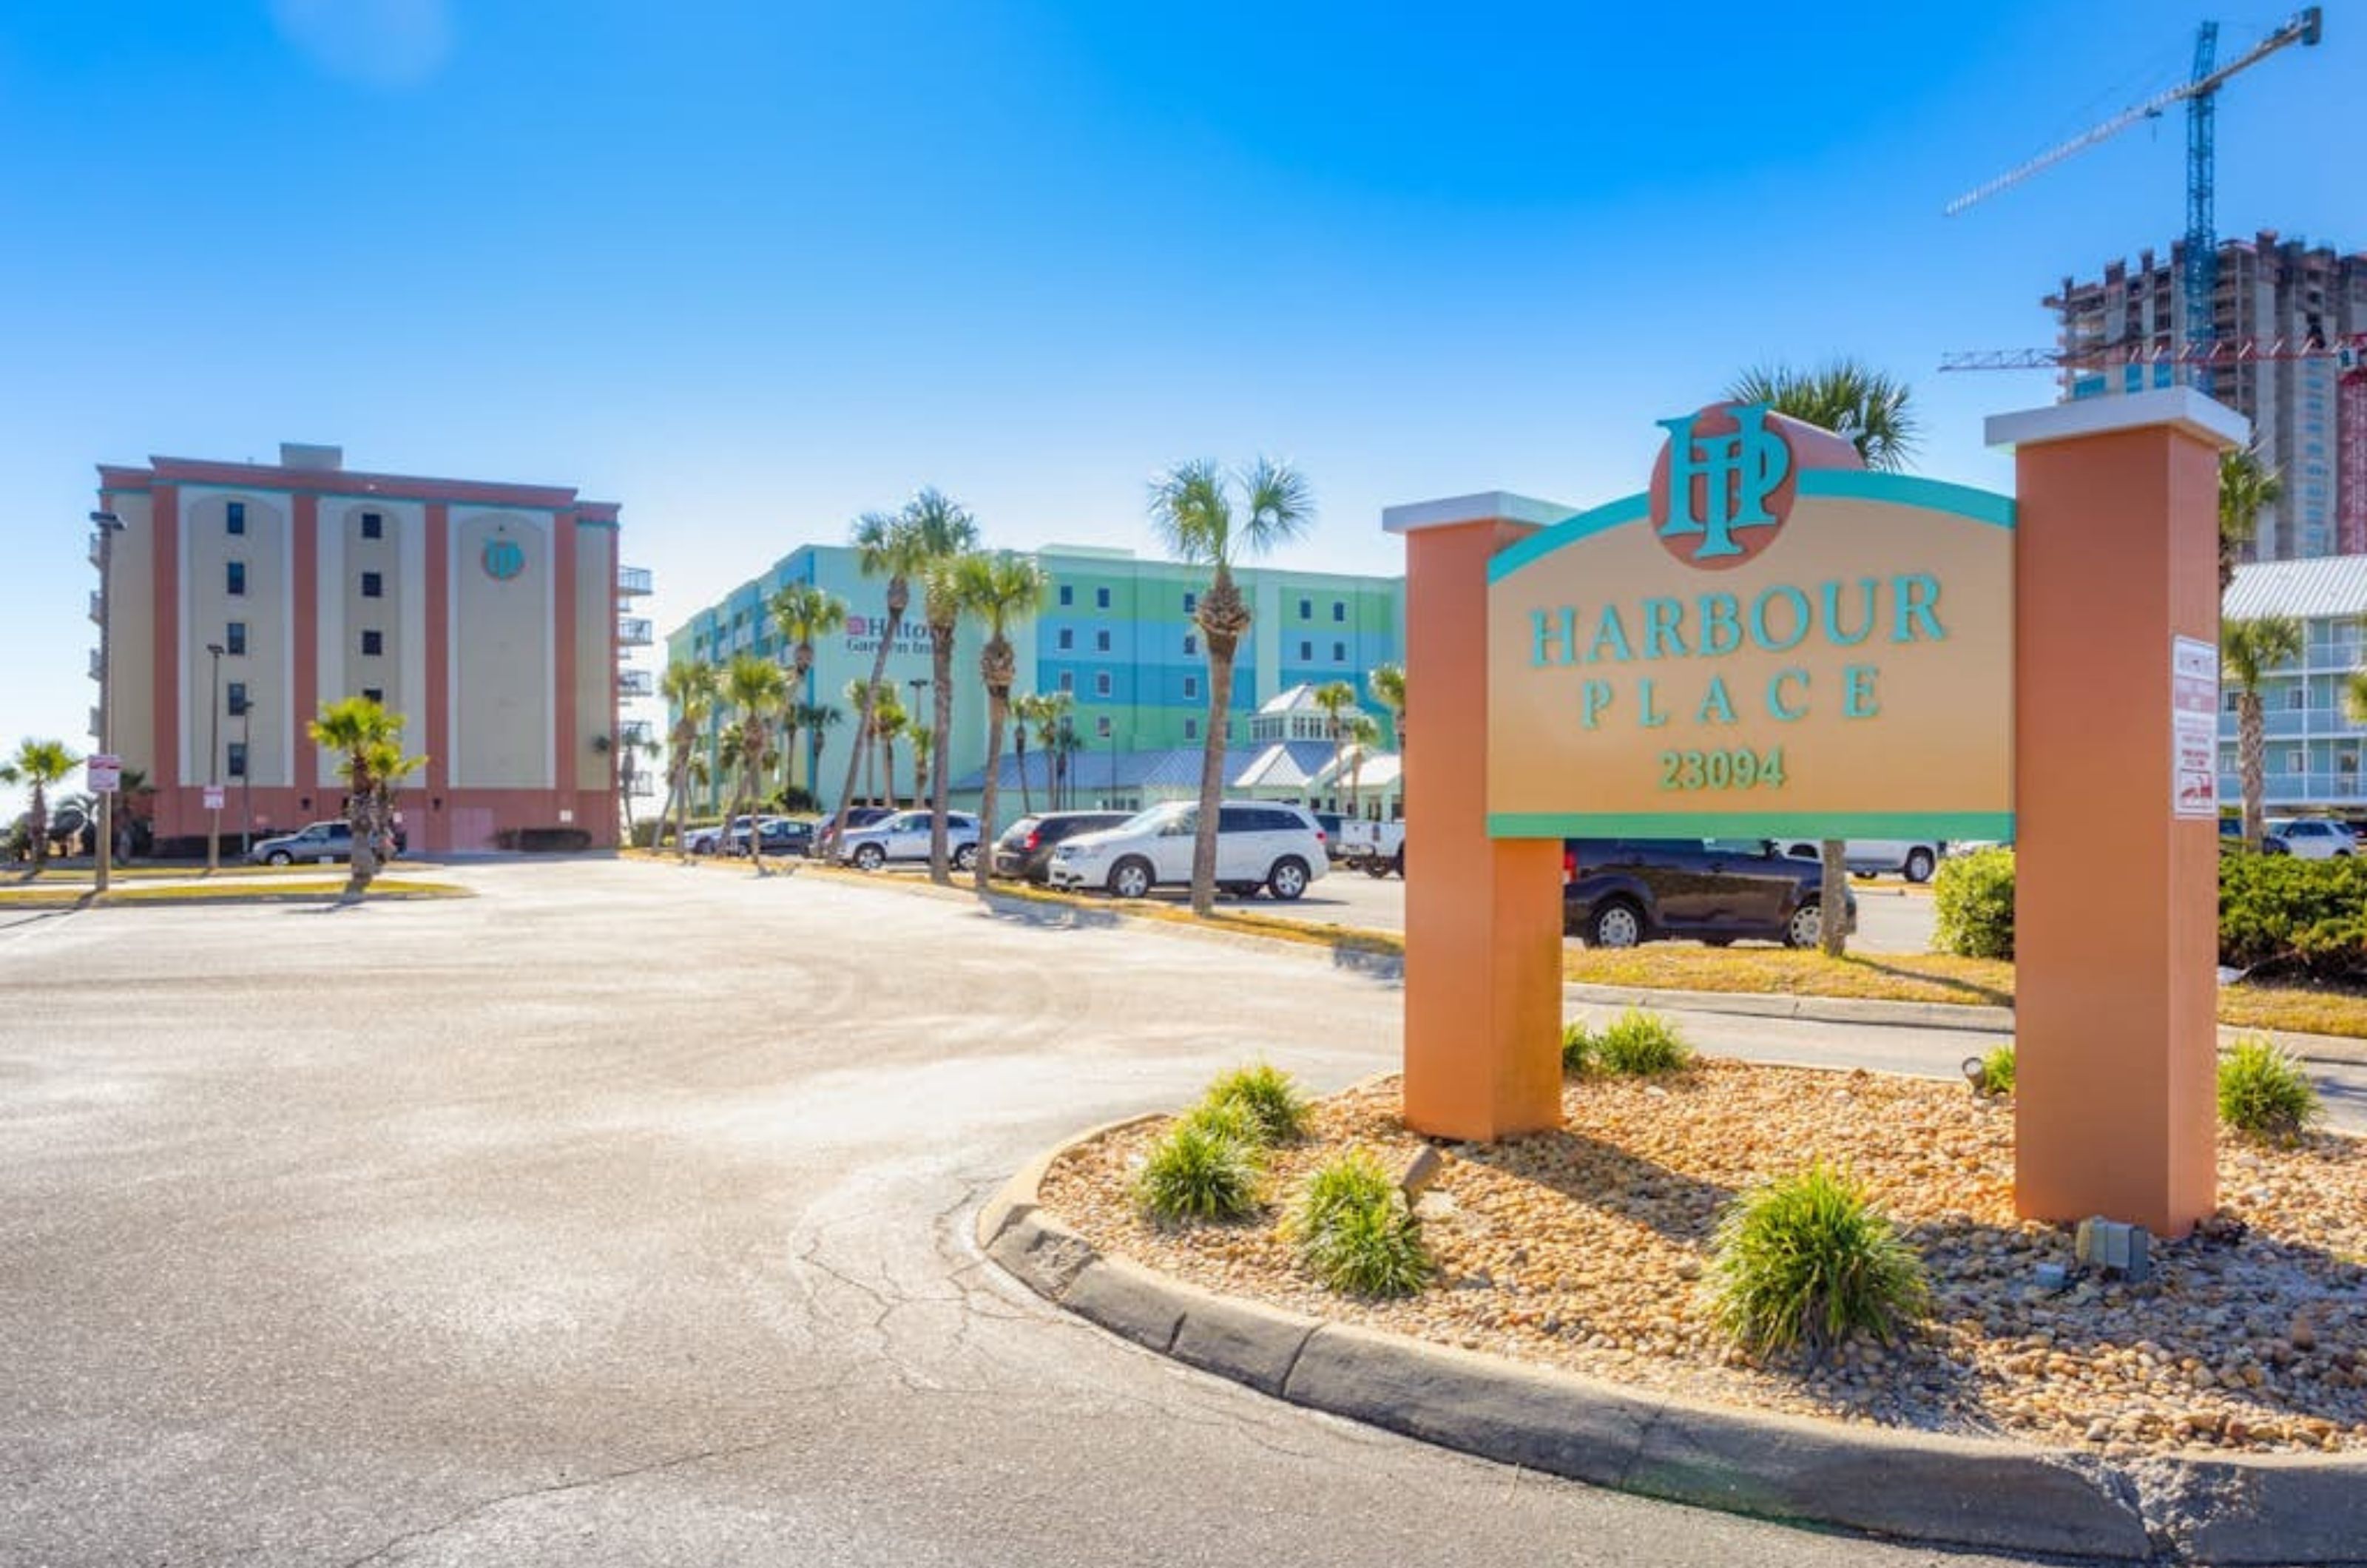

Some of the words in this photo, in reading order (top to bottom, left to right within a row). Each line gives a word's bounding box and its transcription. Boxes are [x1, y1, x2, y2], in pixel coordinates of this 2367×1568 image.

[868, 617, 935, 638] Hlto
[1529, 573, 1948, 669] HARBOUR
[1581, 665, 1880, 729] PLACE
[1659, 747, 1786, 791] 23094
